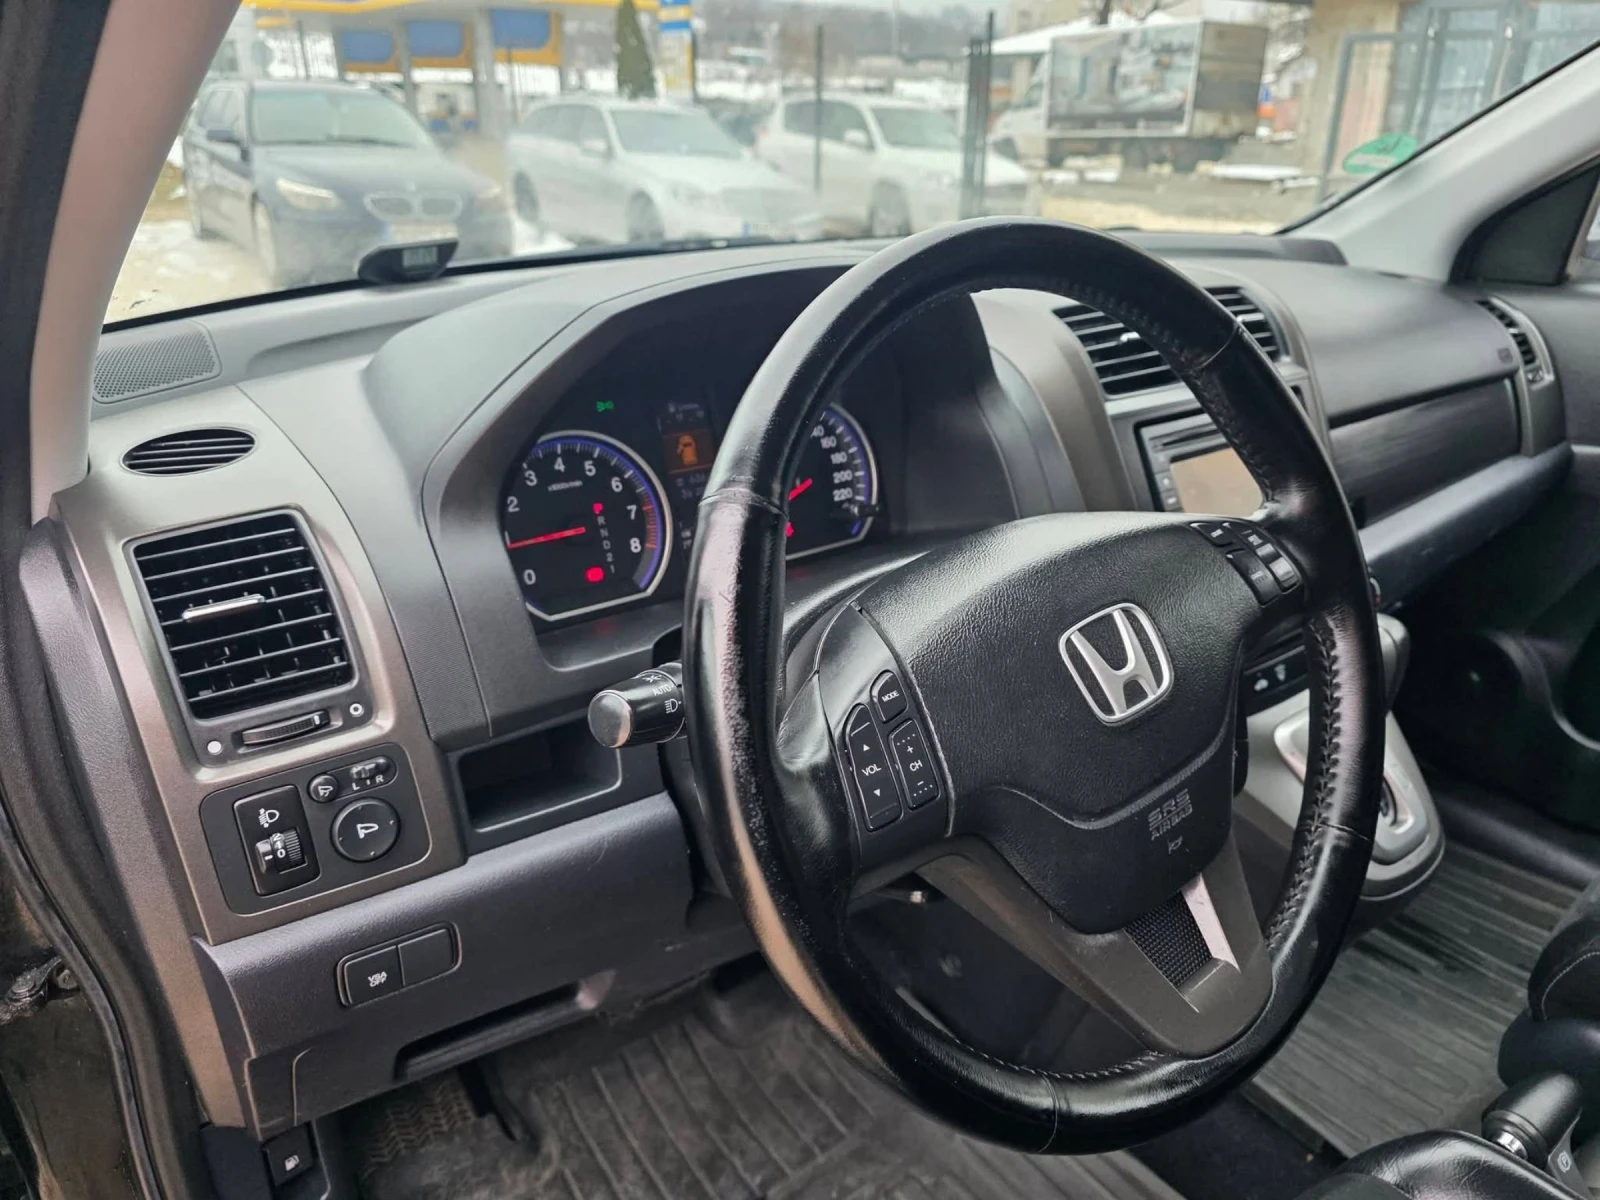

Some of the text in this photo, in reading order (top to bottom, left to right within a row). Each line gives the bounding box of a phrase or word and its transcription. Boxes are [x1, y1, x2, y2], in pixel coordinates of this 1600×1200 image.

[554, 457, 566, 472] 4
[584, 460, 596, 476] 5
[524, 470, 537, 486] 3
[832, 469, 853, 484] 200
[611, 477, 623, 492] 6
[832, 487, 853, 502] 220
[507, 496, 520, 512] 2
[627, 504, 637, 520] 7
[630, 537, 641, 553] 8
[523, 569, 536, 585] 0
[652, 684, 672, 696] AUTO
[882, 690, 899, 702] MODE
[861, 764, 882, 777] VOL
[909, 760, 923, 772] CH
[352, 775, 384, 790] L R
[1147, 788, 1190, 828] SRS
[368, 971, 387, 983] VSA
[370, 977, 386, 987] OFF
